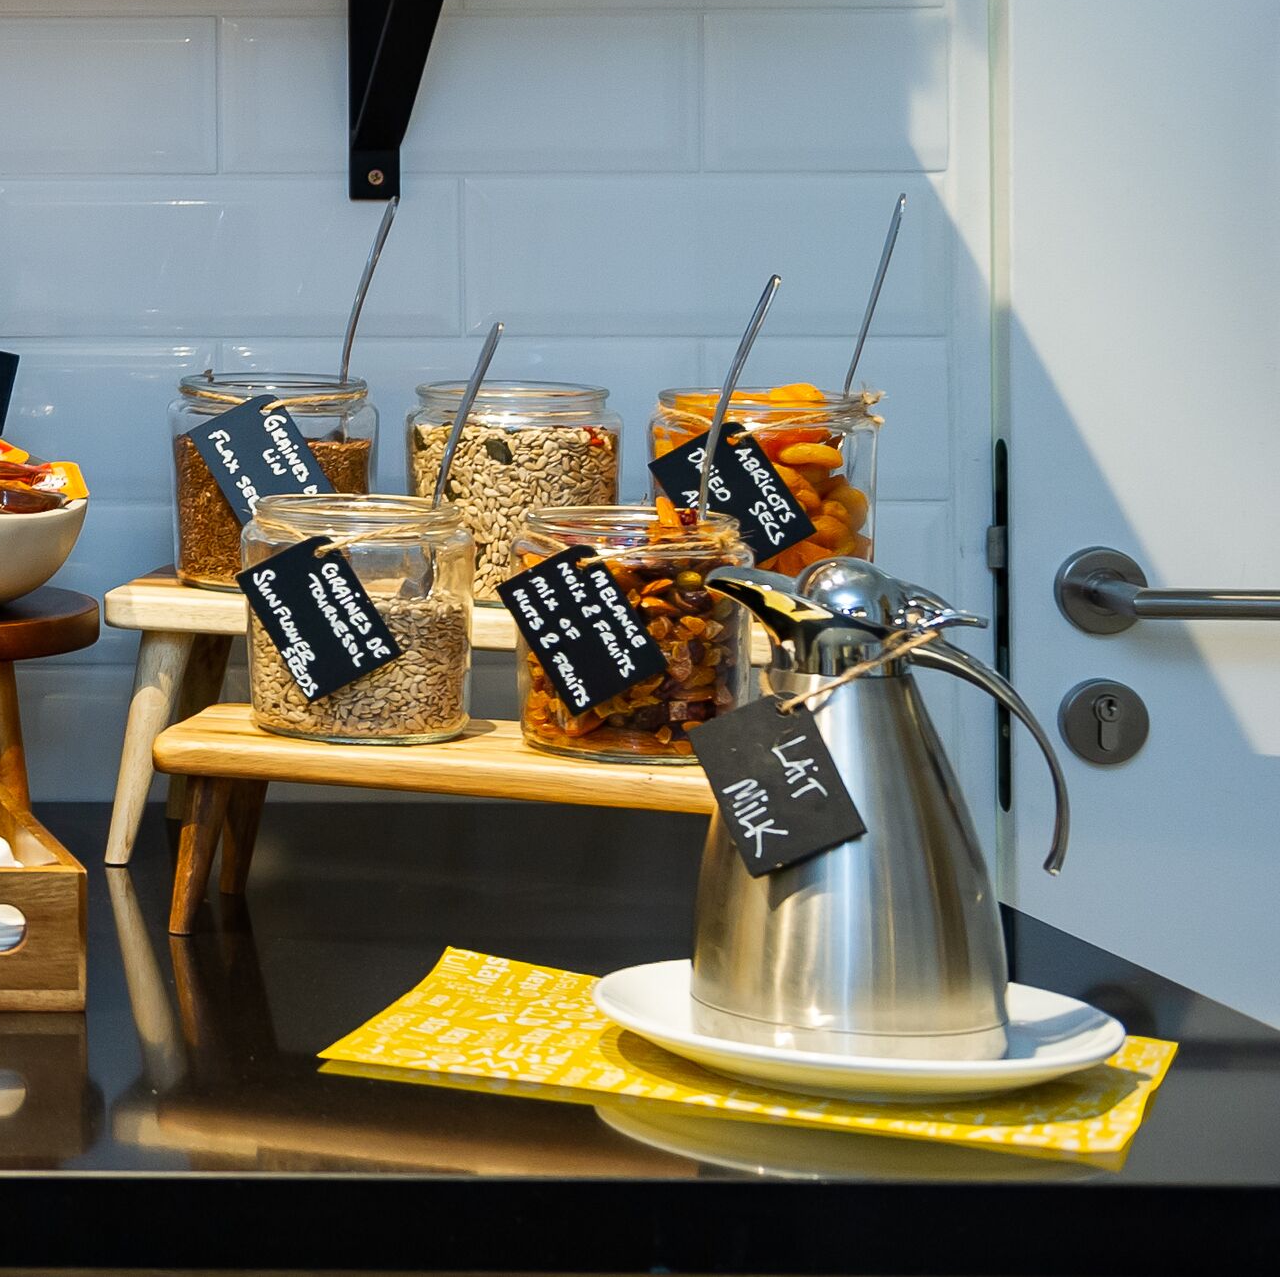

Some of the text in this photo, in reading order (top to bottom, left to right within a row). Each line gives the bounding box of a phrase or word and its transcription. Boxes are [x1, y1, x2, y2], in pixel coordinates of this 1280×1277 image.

[208, 429, 240, 474] FLAX
[748, 500, 786, 546] SECS
[308, 573, 365, 668] TOURNESOL
[512, 588, 545, 631] NUTS
[559, 617, 581, 640] OF
[590, 570, 648, 648] MELANGE
[366, 637, 391, 659] DE
[466, 955, 512, 987] stay
